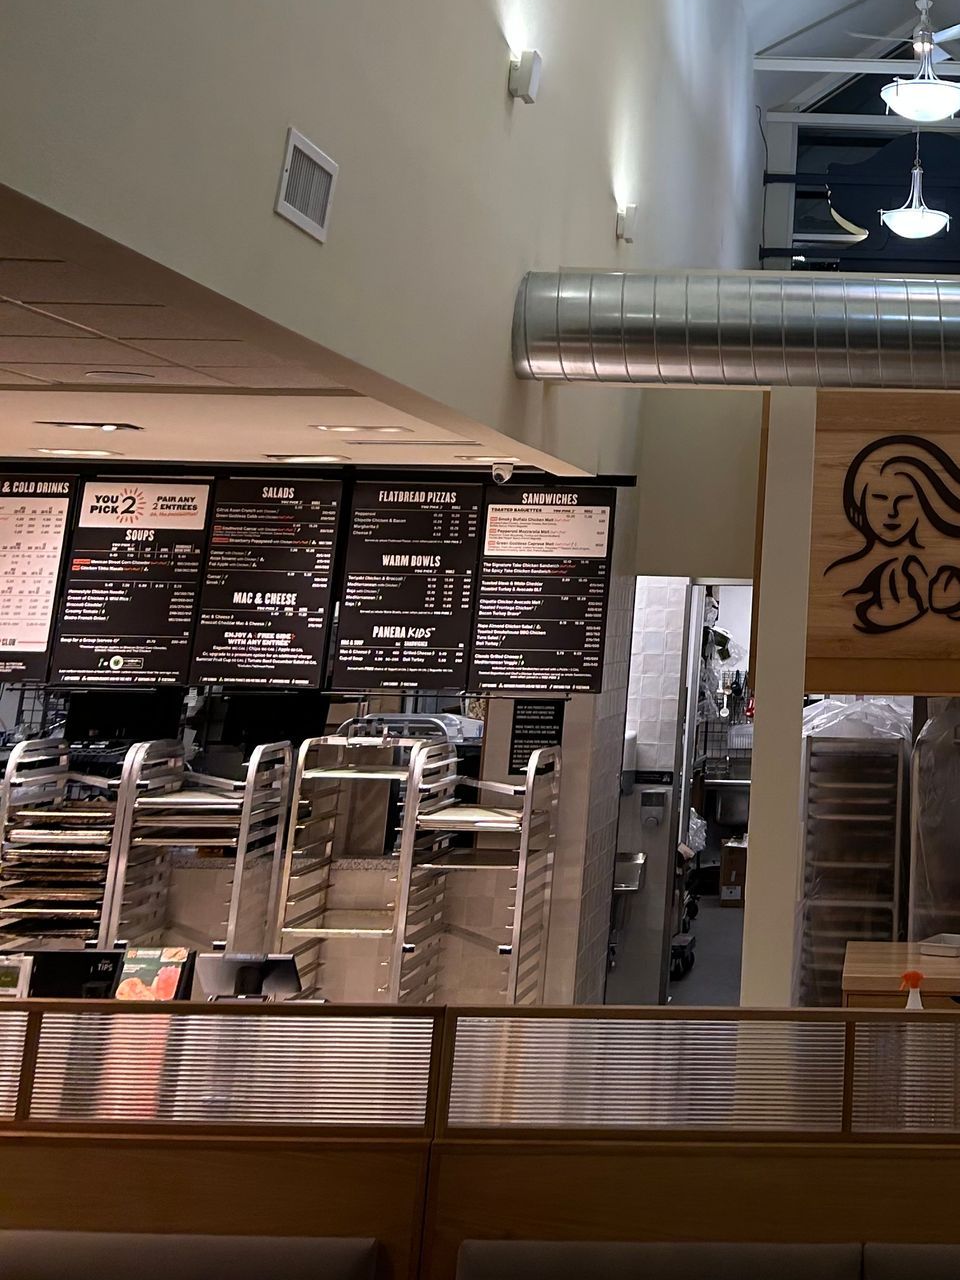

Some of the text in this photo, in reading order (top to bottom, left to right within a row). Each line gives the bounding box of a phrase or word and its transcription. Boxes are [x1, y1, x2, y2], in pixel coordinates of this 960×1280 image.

[2, 481, 70, 494] & COLD DRINKS
[262, 486, 295, 499] SALADS
[94, 494, 120, 504] YOU
[378, 490, 457, 504] FLATBREAD PIZZAS
[522, 492, 578, 505] SANDWICHES
[90, 496, 137, 515] PICK 2
[125, 529, 155, 541] SOUPS
[382, 554, 441, 567] WARM BOWLS
[233, 592, 297, 606] MAC & CHEESE
[372, 626, 406, 638] PANERA
